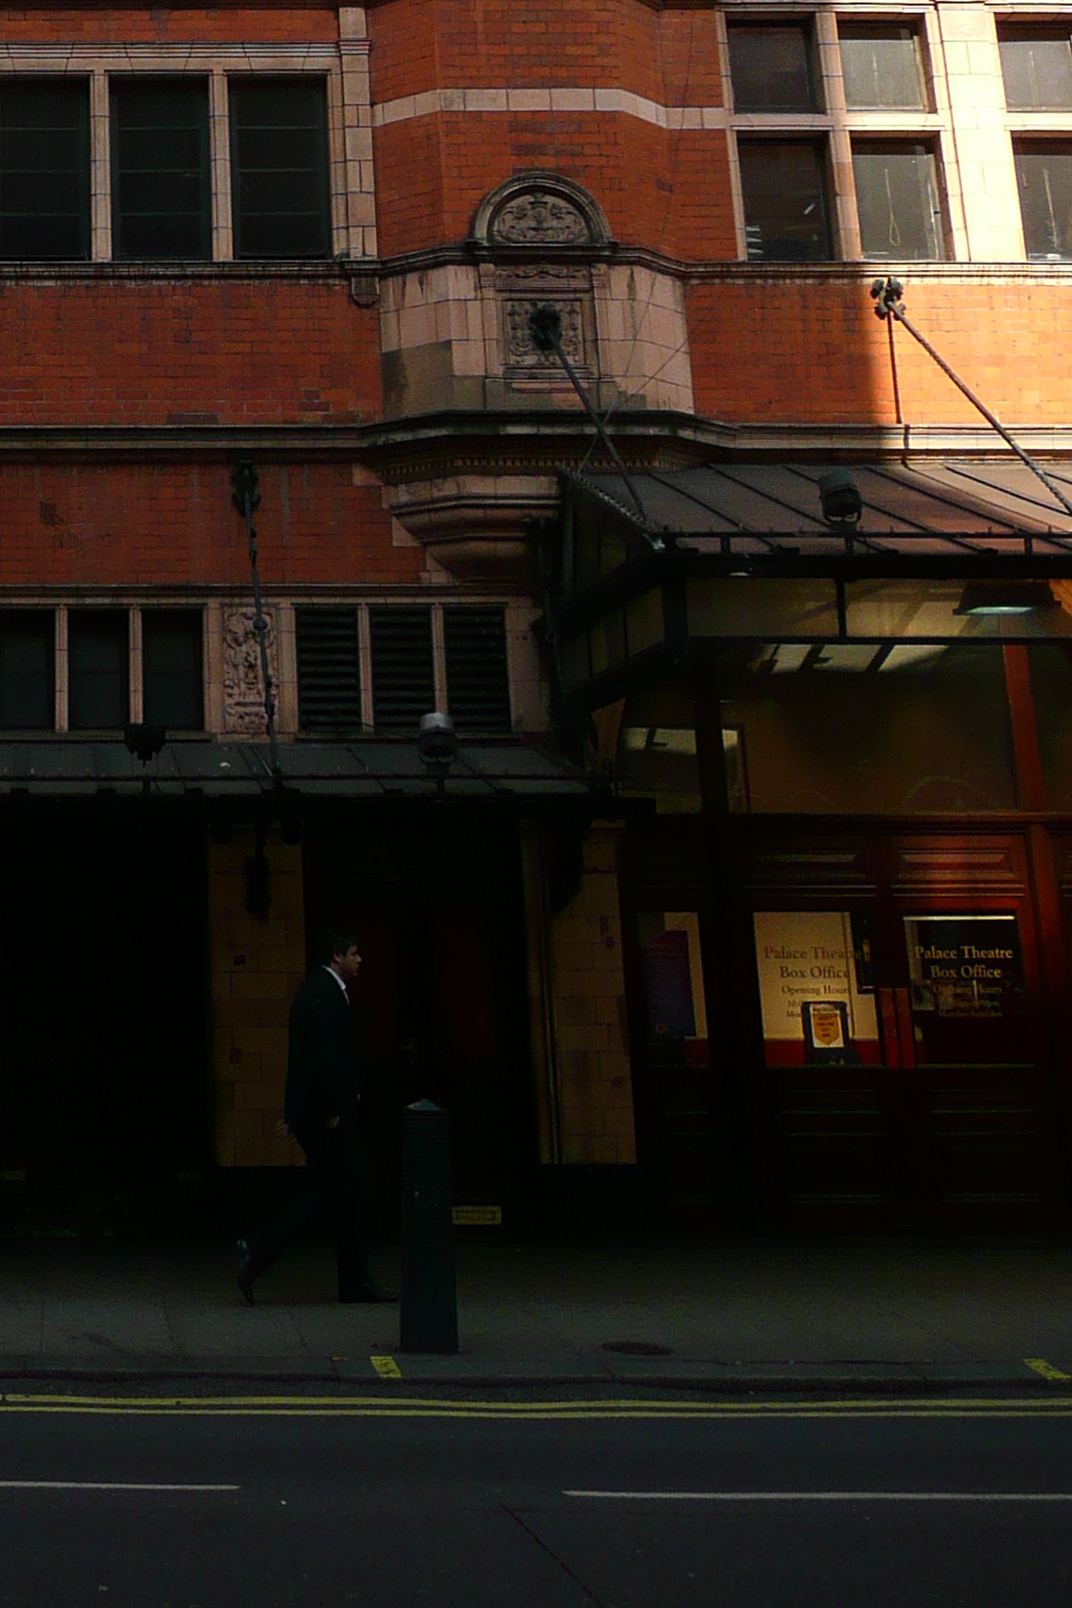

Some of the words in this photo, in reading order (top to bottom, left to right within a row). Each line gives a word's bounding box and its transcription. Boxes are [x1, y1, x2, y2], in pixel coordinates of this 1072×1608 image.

[764, 946, 807, 959] Palace
[914, 944, 958, 959] Palace
[960, 944, 1014, 959] Theatre
[780, 966, 806, 978] Box
[810, 965, 849, 979] Office
[930, 964, 957, 978] Box
[960, 963, 1003, 979] Office
[782, 985, 821, 996] Opening
